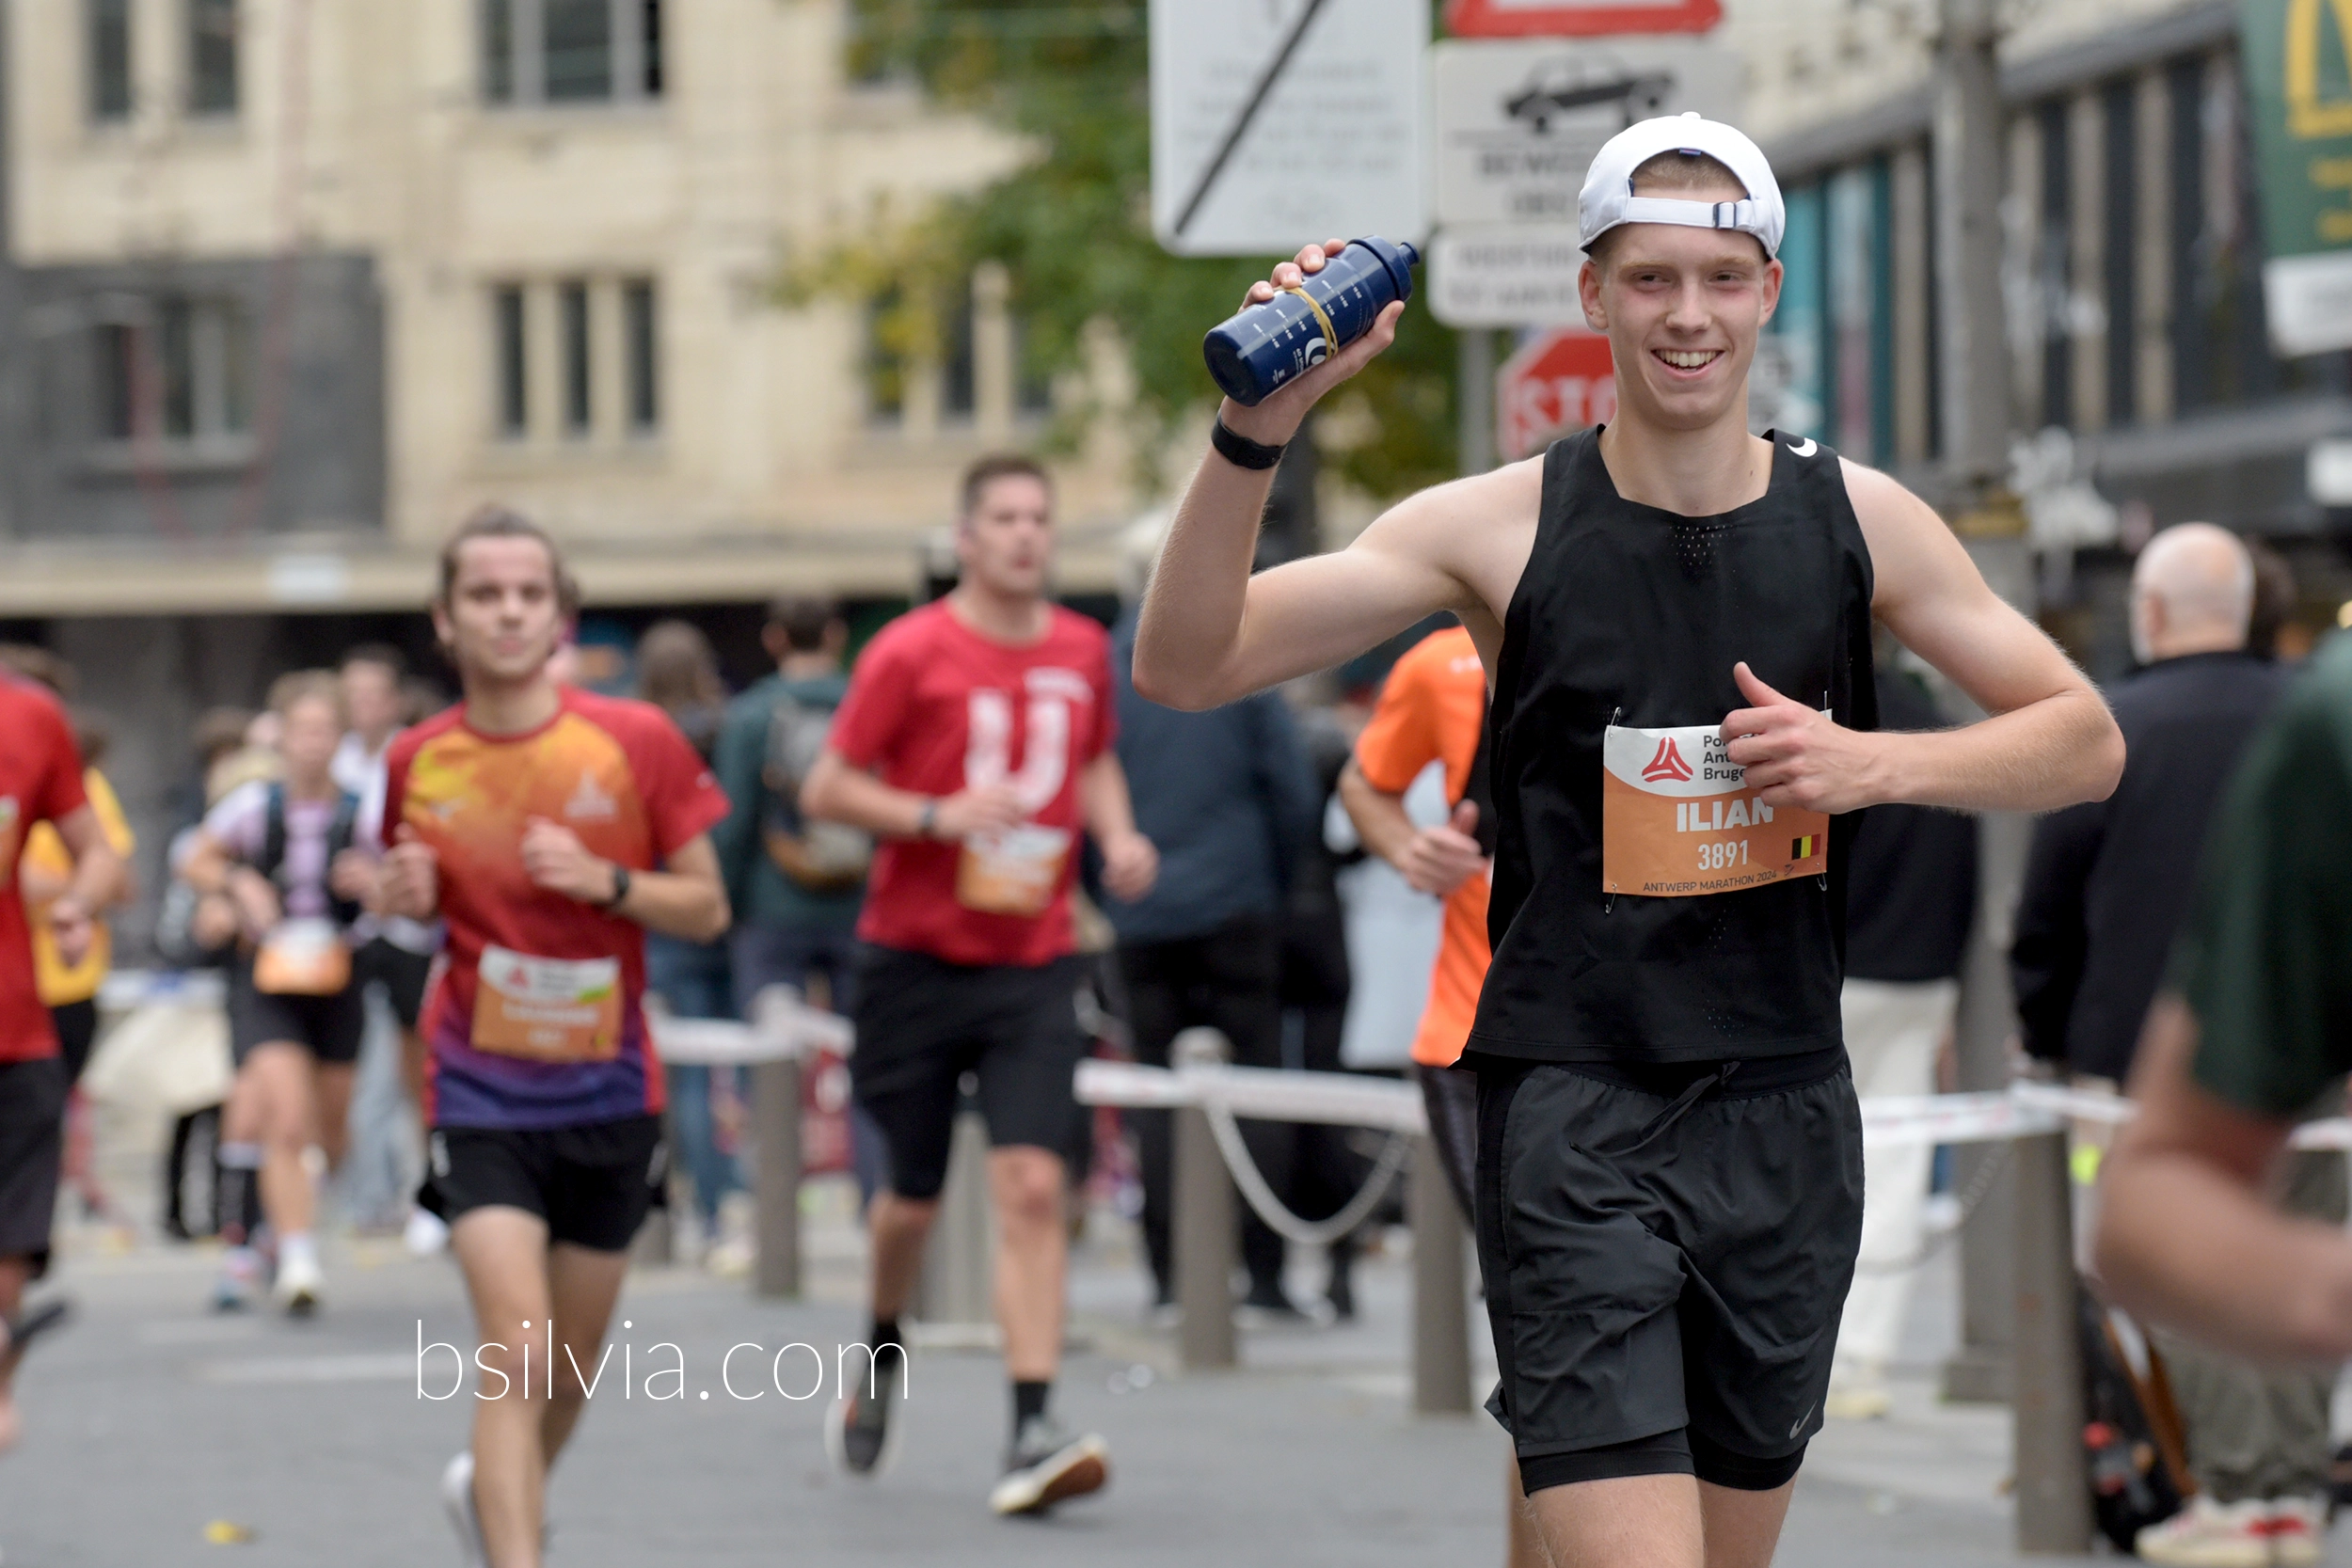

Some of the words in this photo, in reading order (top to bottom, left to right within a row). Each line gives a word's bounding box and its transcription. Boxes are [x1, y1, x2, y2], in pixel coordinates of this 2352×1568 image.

[1677, 796, 1774, 832] ILIAN
[1697, 839, 1749, 870] 3891
[1643, 880, 1697, 893] ANTWERP
[1699, 874, 1756, 892] MARATHON
[1756, 869, 1777, 882] 2024
